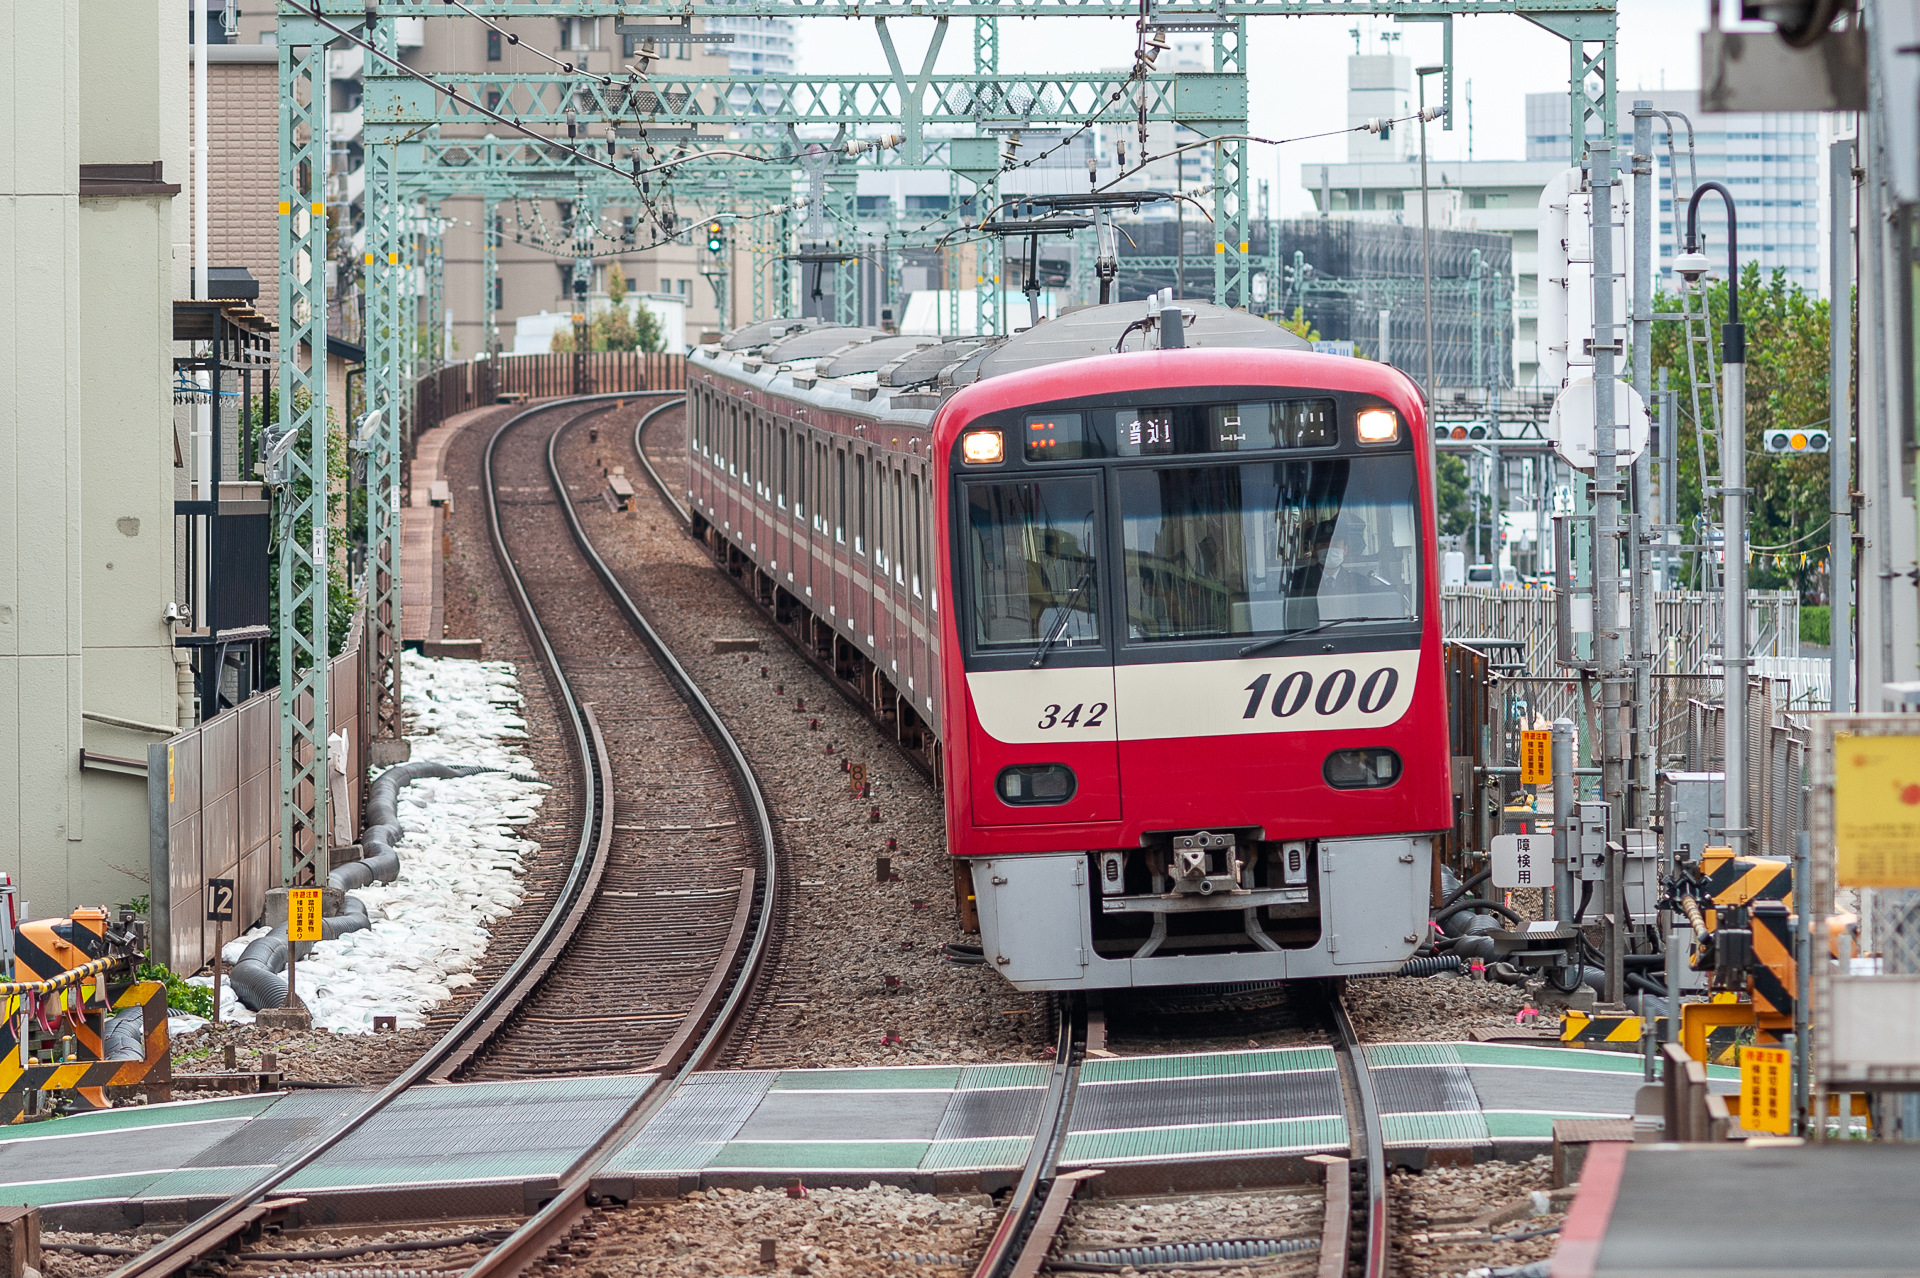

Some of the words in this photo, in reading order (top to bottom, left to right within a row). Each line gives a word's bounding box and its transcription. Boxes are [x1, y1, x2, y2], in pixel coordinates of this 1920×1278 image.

[1242, 667, 1399, 720] 1000
[1037, 702, 1109, 730] 342
[1517, 838, 1531, 884] 障検用
[208, 885, 233, 914] 12
